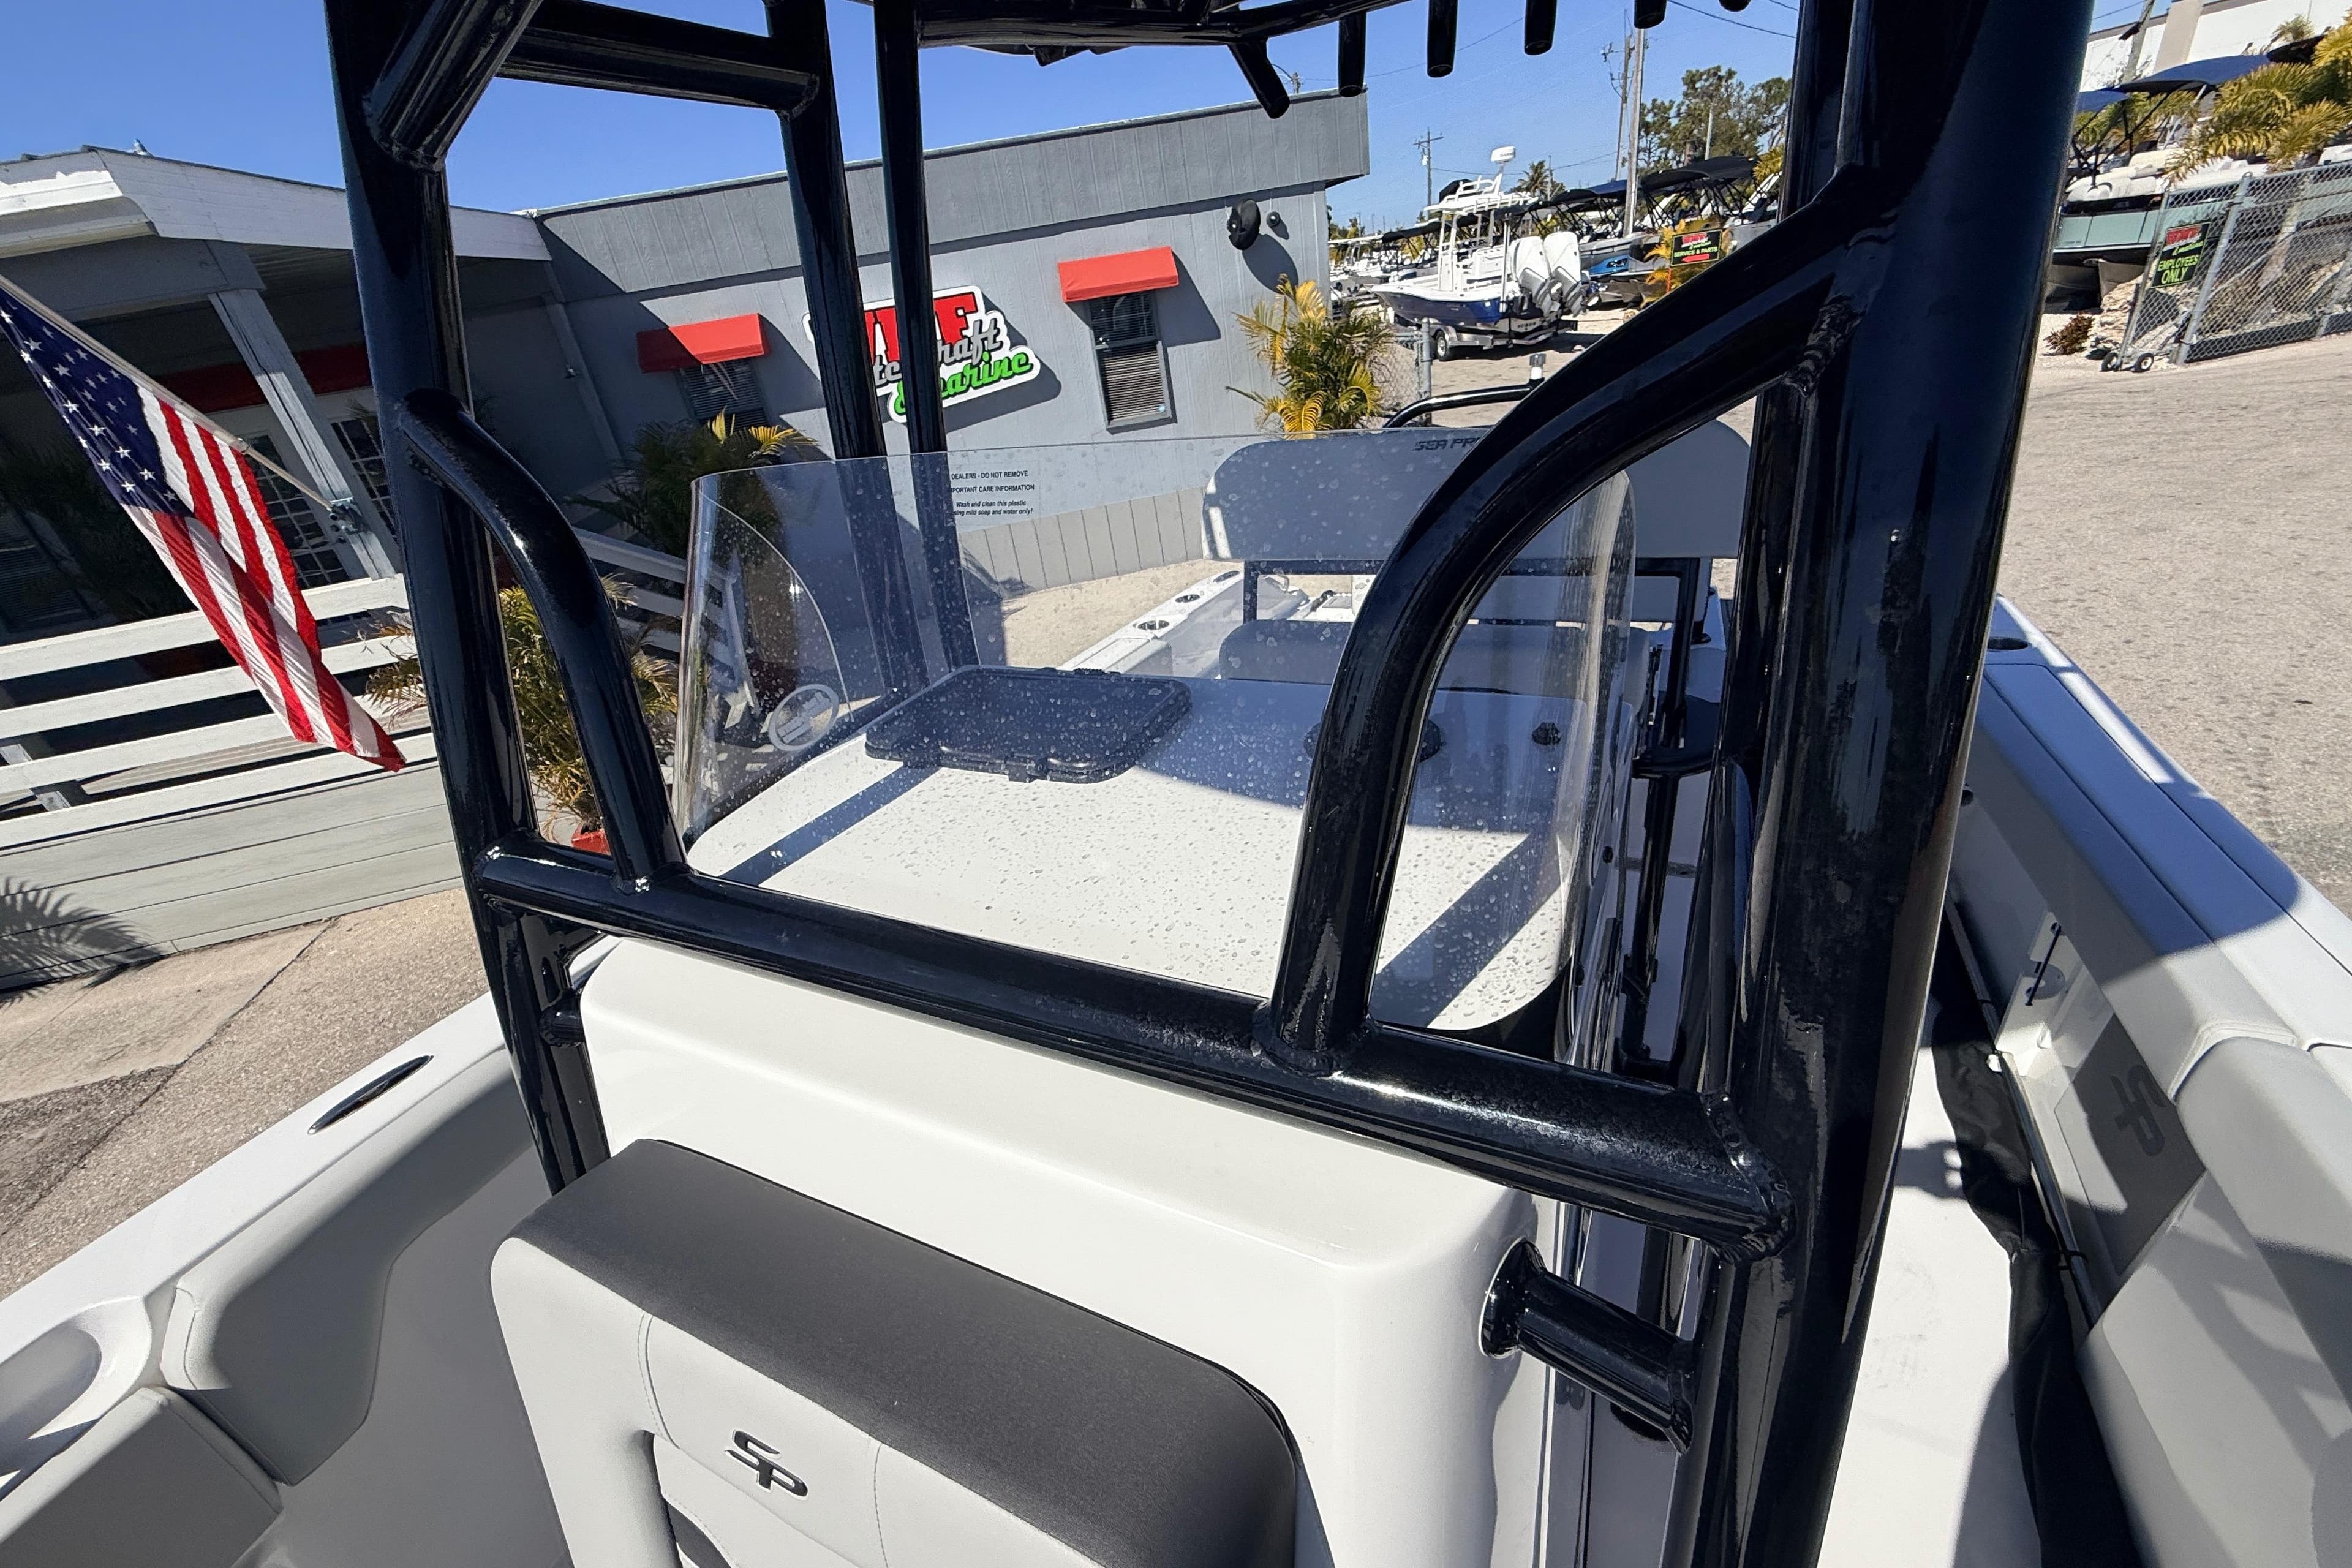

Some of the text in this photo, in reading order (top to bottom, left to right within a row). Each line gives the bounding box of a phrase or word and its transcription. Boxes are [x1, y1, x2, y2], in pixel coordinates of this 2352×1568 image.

[2157, 254, 2199, 271] EMPLOYEES
[2161, 266, 2188, 284] ONLY
[940, 350, 1031, 398] arine
[1413, 439, 1448, 451] SEA
